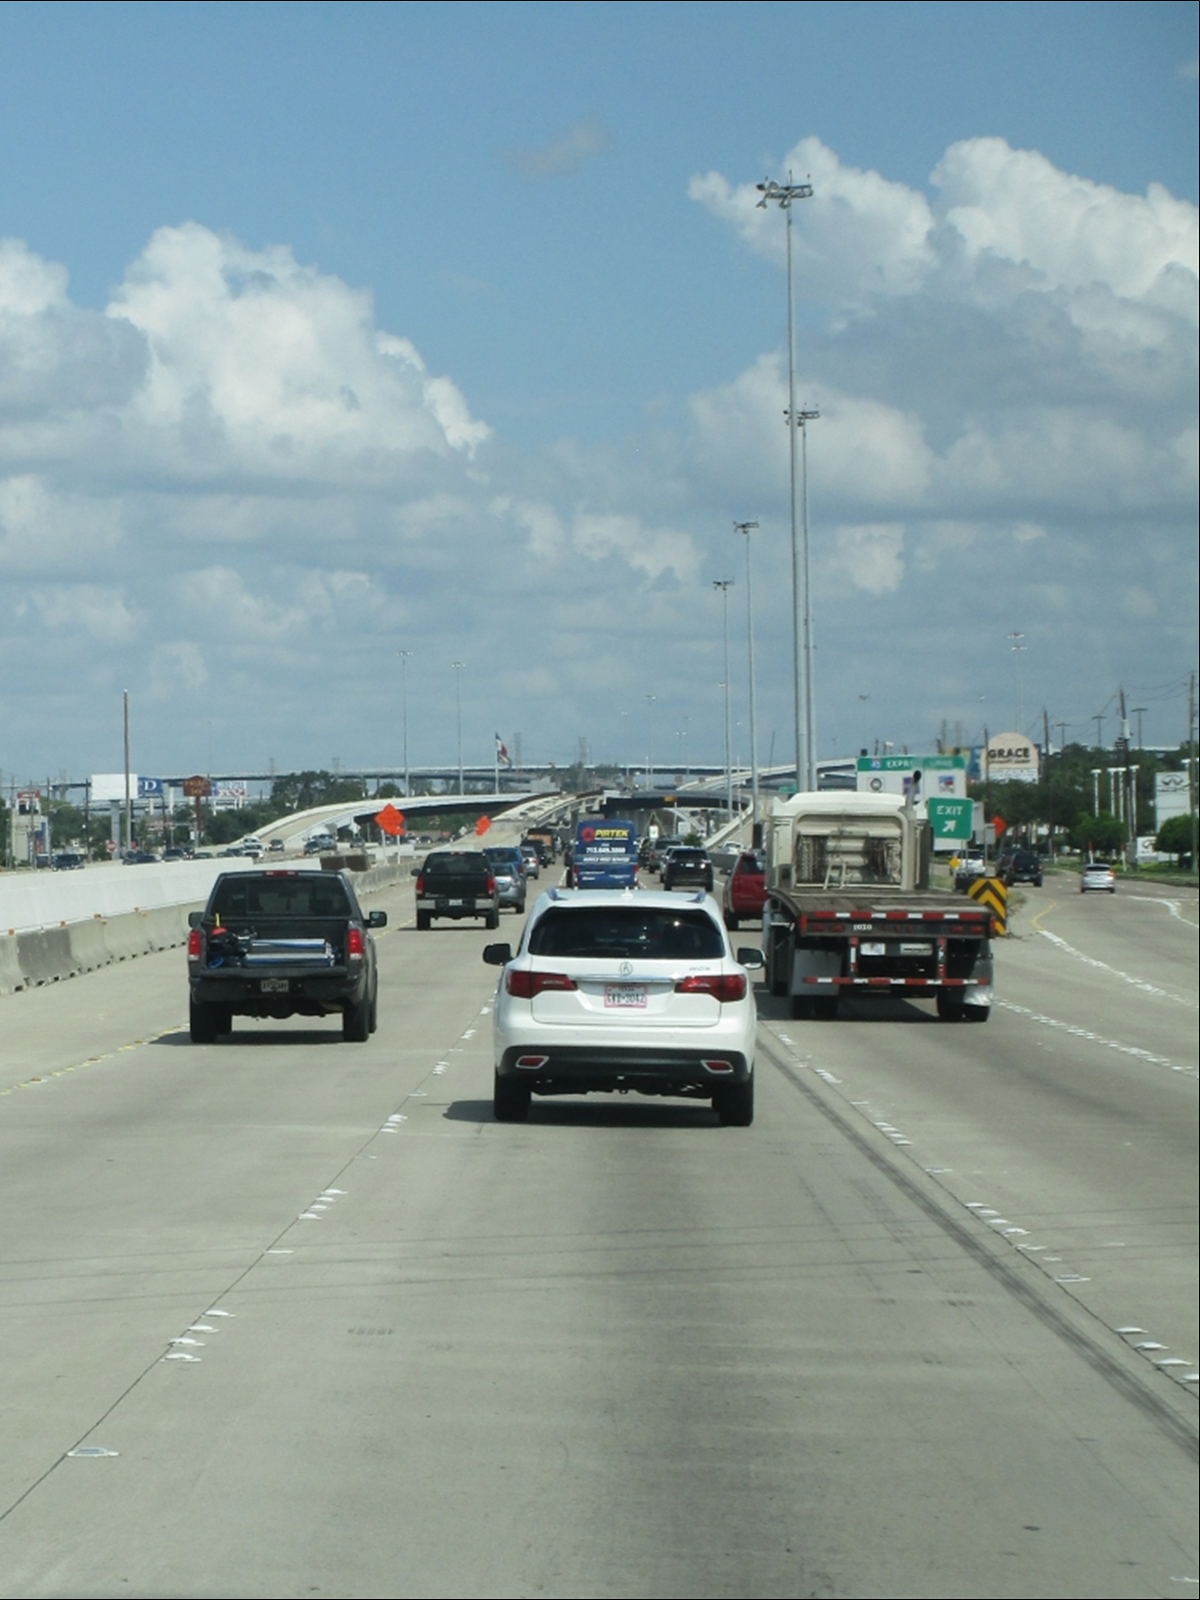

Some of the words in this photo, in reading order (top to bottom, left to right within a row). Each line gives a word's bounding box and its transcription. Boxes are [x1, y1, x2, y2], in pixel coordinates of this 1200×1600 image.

[988, 747, 1030, 759] GRACE
[936, 805, 964, 815] EXIT
[595, 829, 629, 838] PIRTEK
